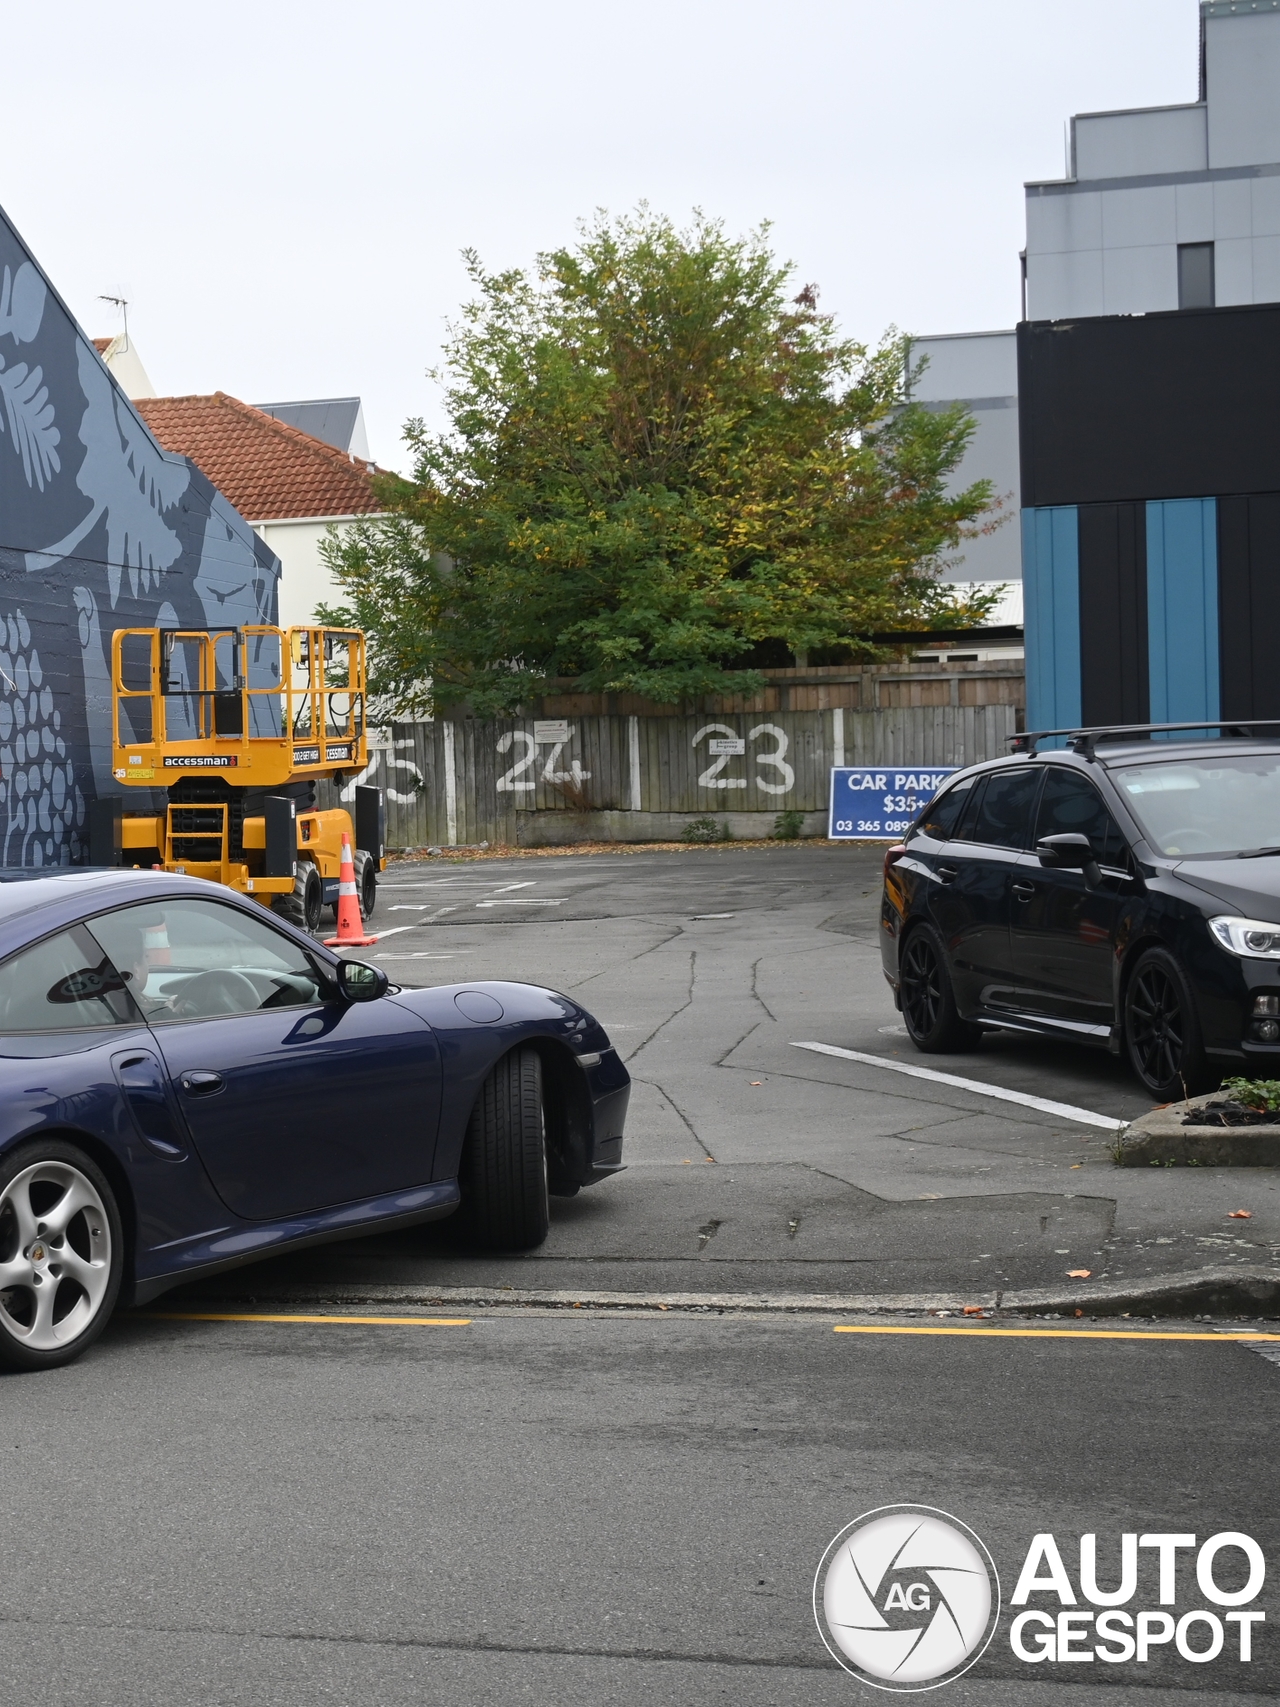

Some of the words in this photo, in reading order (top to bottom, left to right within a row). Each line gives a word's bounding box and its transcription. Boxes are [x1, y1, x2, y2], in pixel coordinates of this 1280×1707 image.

[326, 747, 348, 760] cessman
[496, 725, 592, 795] 24
[692, 723, 795, 795] 23
[164, 757, 228, 767] accessman
[115, 769, 126, 778] 35
[848, 774, 888, 791] CAR
[883, 794, 929, 814] $35+
[836, 820, 853, 832] 03
[857, 820, 881, 832] 365
[885, 820, 916, 832] 089
